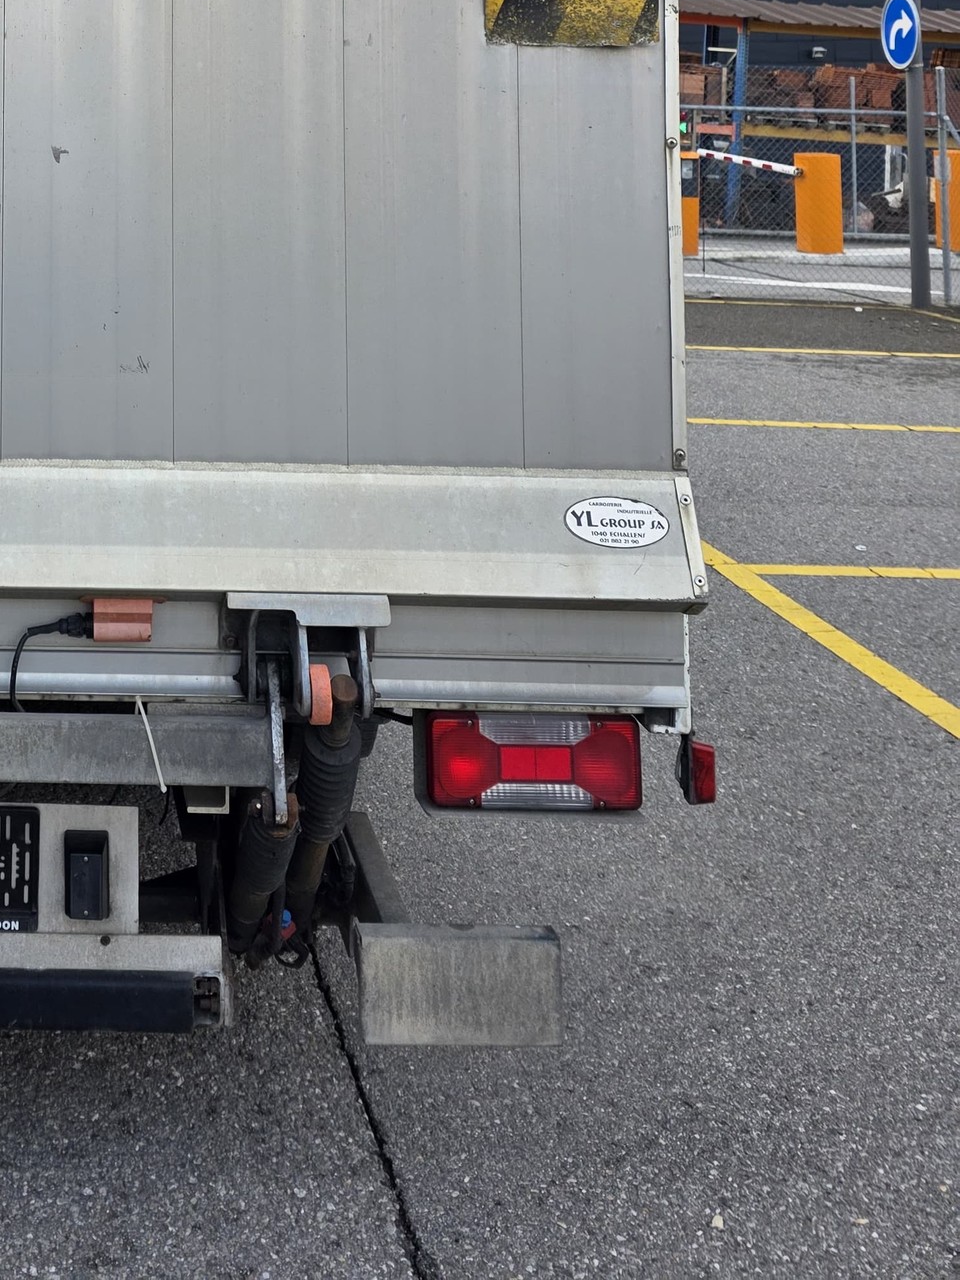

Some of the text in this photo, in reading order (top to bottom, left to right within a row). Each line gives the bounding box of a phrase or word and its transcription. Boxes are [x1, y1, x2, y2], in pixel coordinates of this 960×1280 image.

[570, 510, 665, 530] YL GROUP SA
